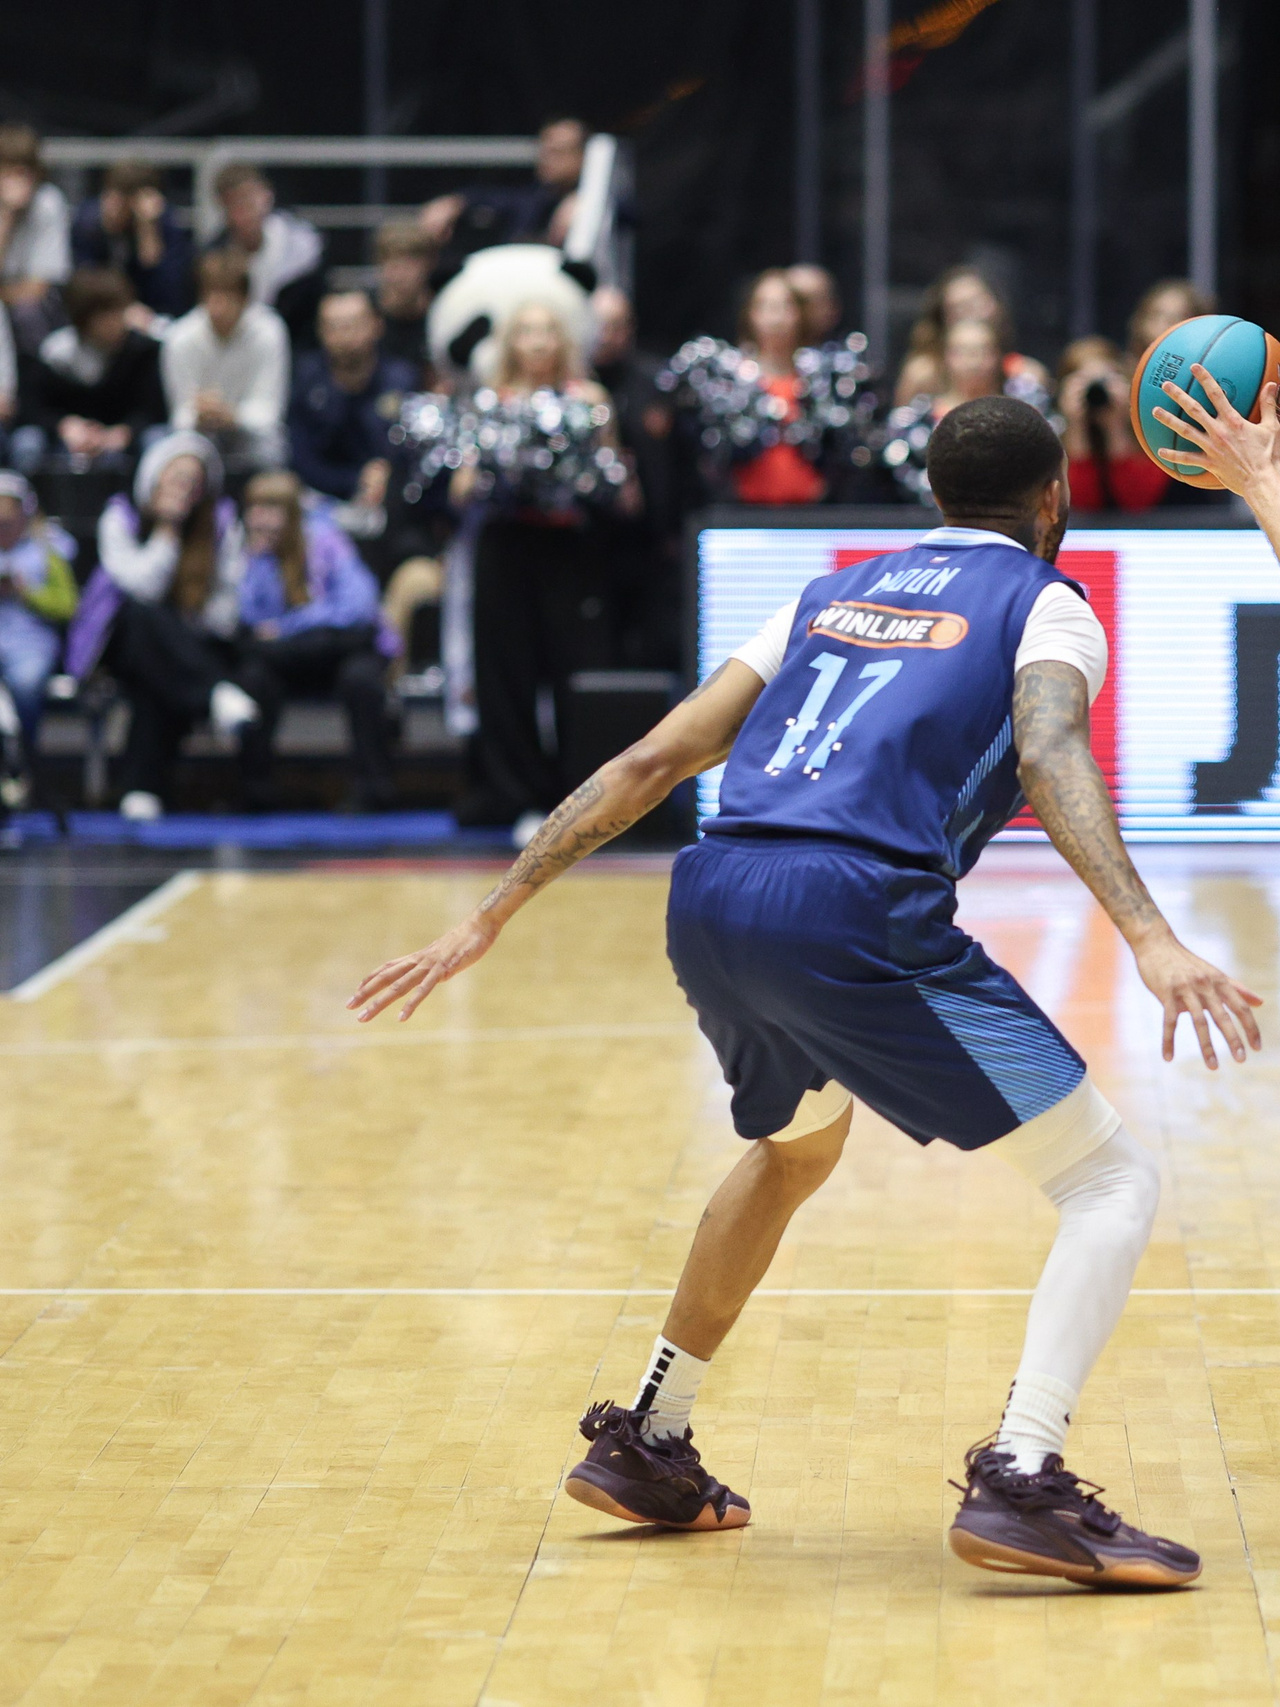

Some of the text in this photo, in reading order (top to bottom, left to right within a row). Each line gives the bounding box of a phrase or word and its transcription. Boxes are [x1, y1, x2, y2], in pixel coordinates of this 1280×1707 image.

[1158, 352, 1186, 389] FIB
[814, 606, 935, 641] WINLINE
[764, 651, 904, 781] 17
